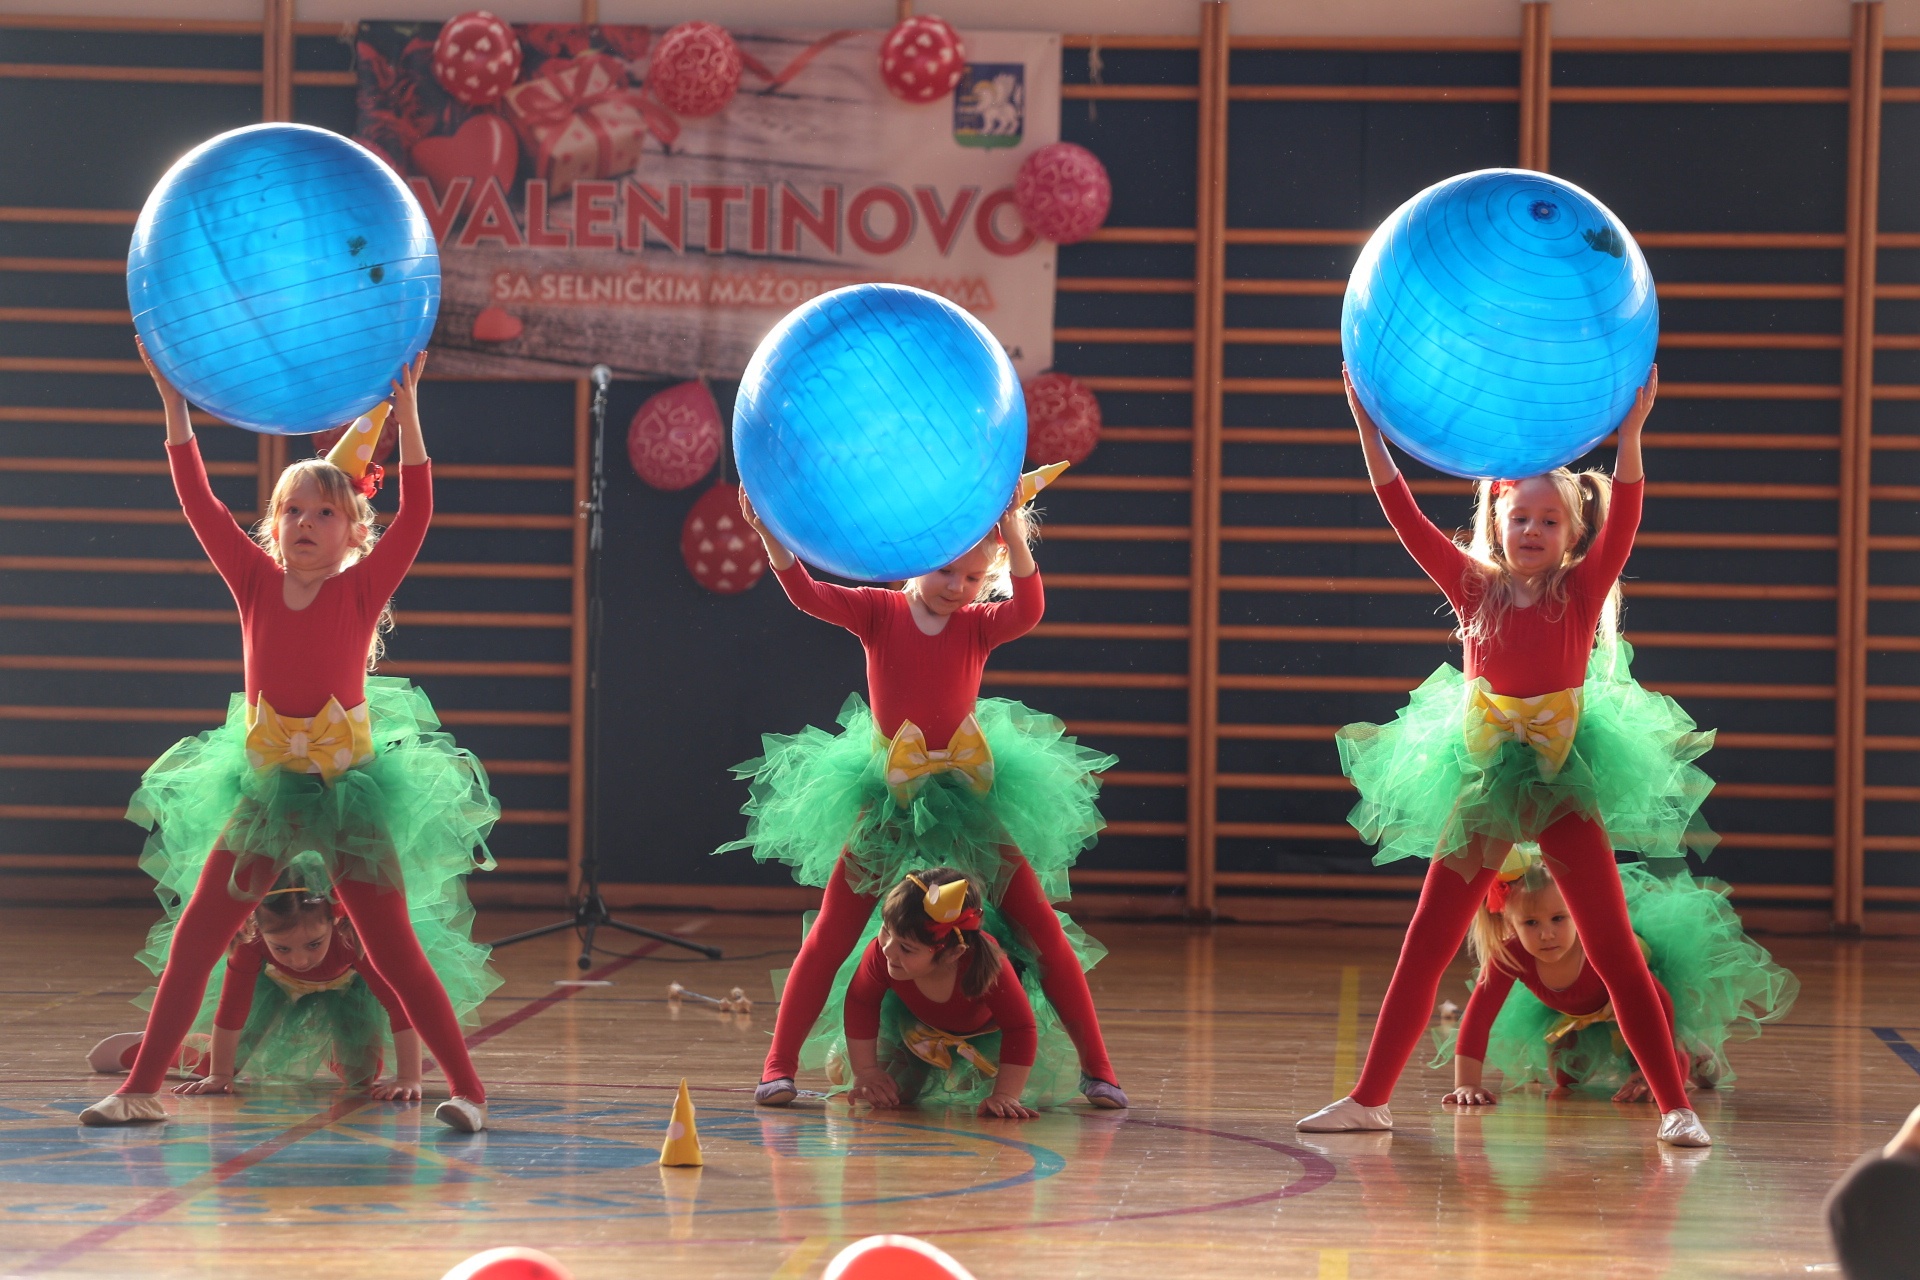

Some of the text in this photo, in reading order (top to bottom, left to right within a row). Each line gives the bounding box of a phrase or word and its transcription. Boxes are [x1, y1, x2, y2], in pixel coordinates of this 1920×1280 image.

[406, 176, 1039, 257] VALENTINOVO
[494, 273, 524, 299] SA
[541, 269, 700, 301] SELNIČKIM
